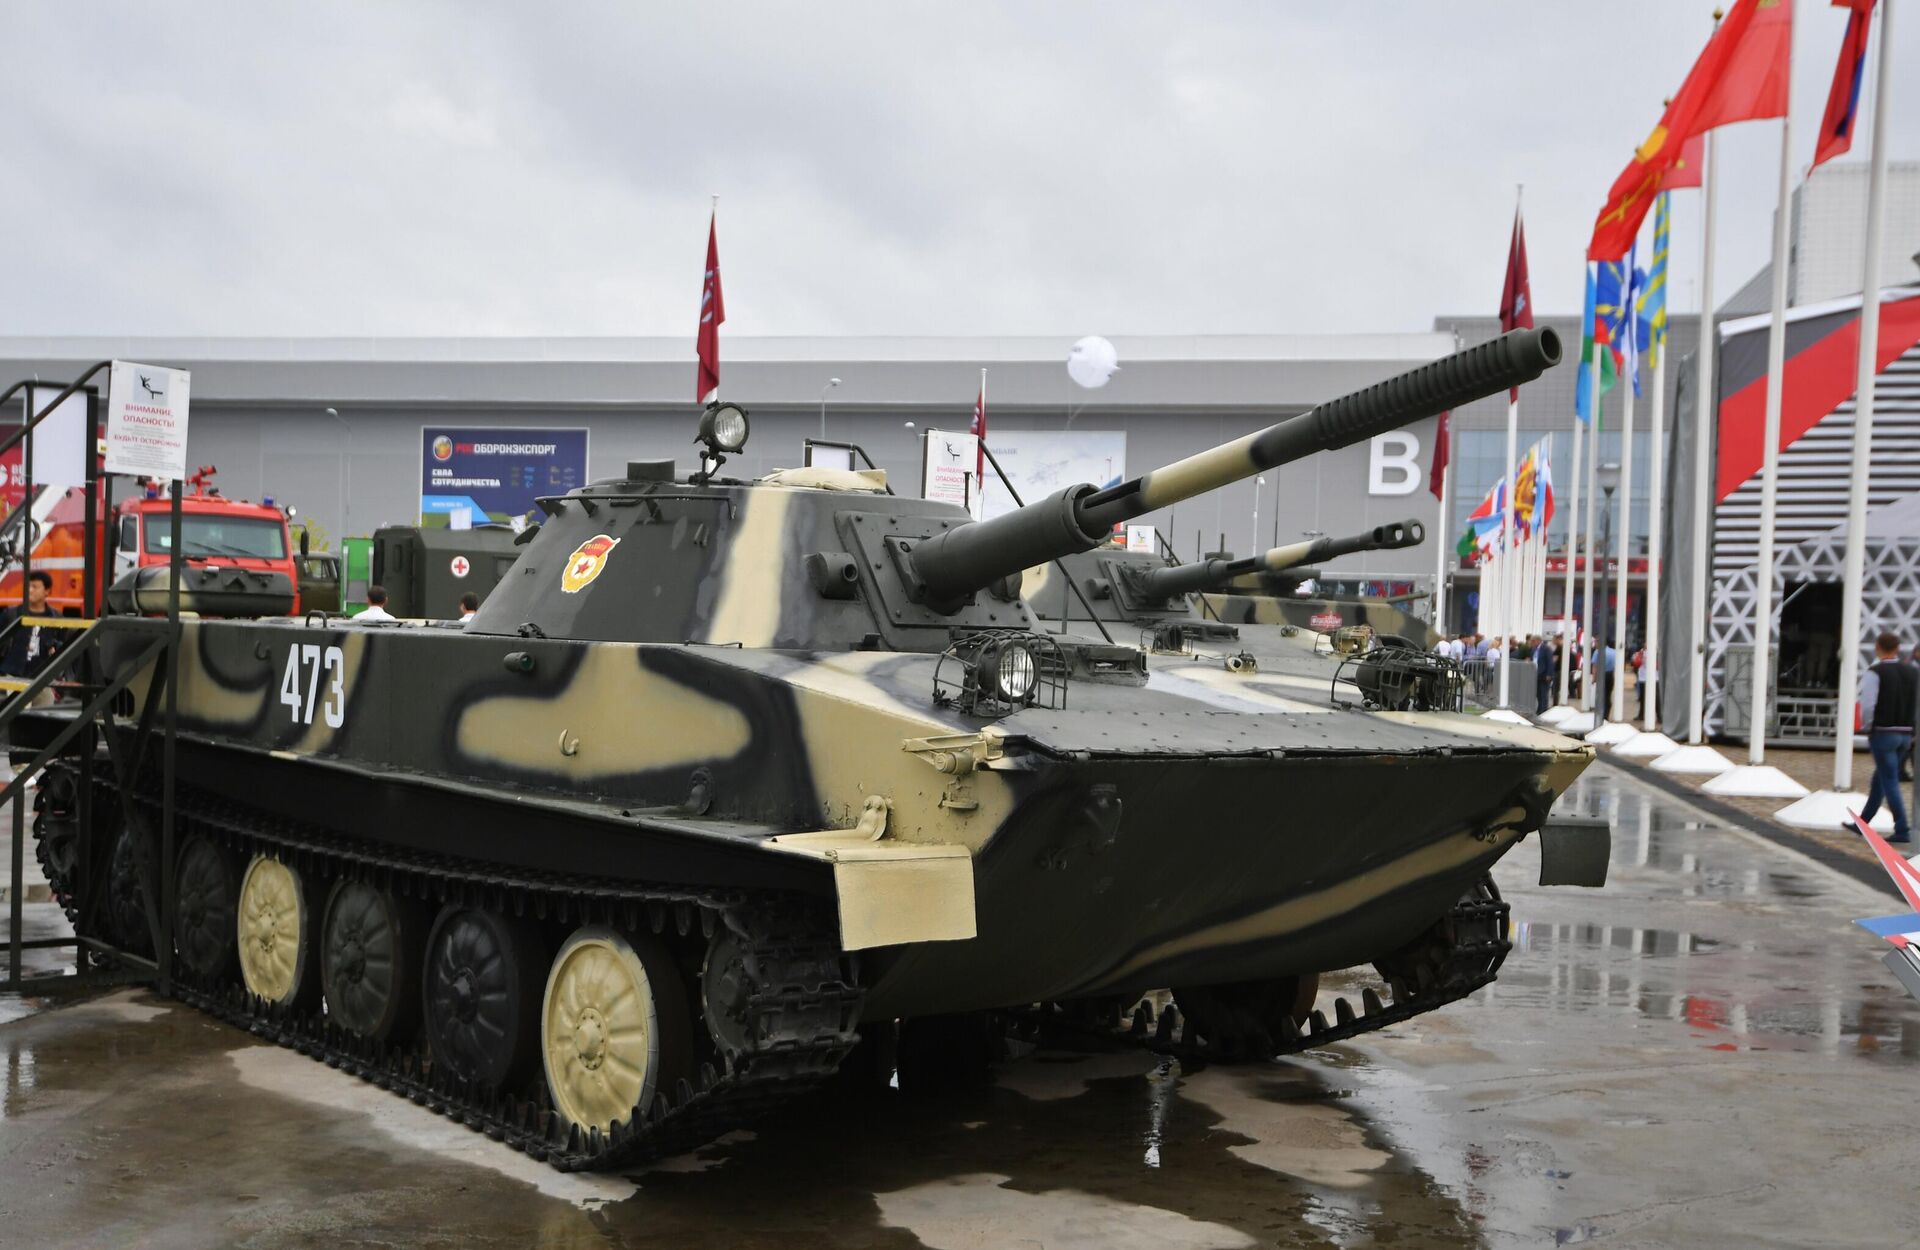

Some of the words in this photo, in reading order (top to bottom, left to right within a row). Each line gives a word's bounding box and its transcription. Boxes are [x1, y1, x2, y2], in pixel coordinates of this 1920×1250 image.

[432, 468, 453, 476] СИЛА
[432, 478, 501, 487] СОТРУДНИЧЕСТВА
[280, 643, 345, 729] 473
